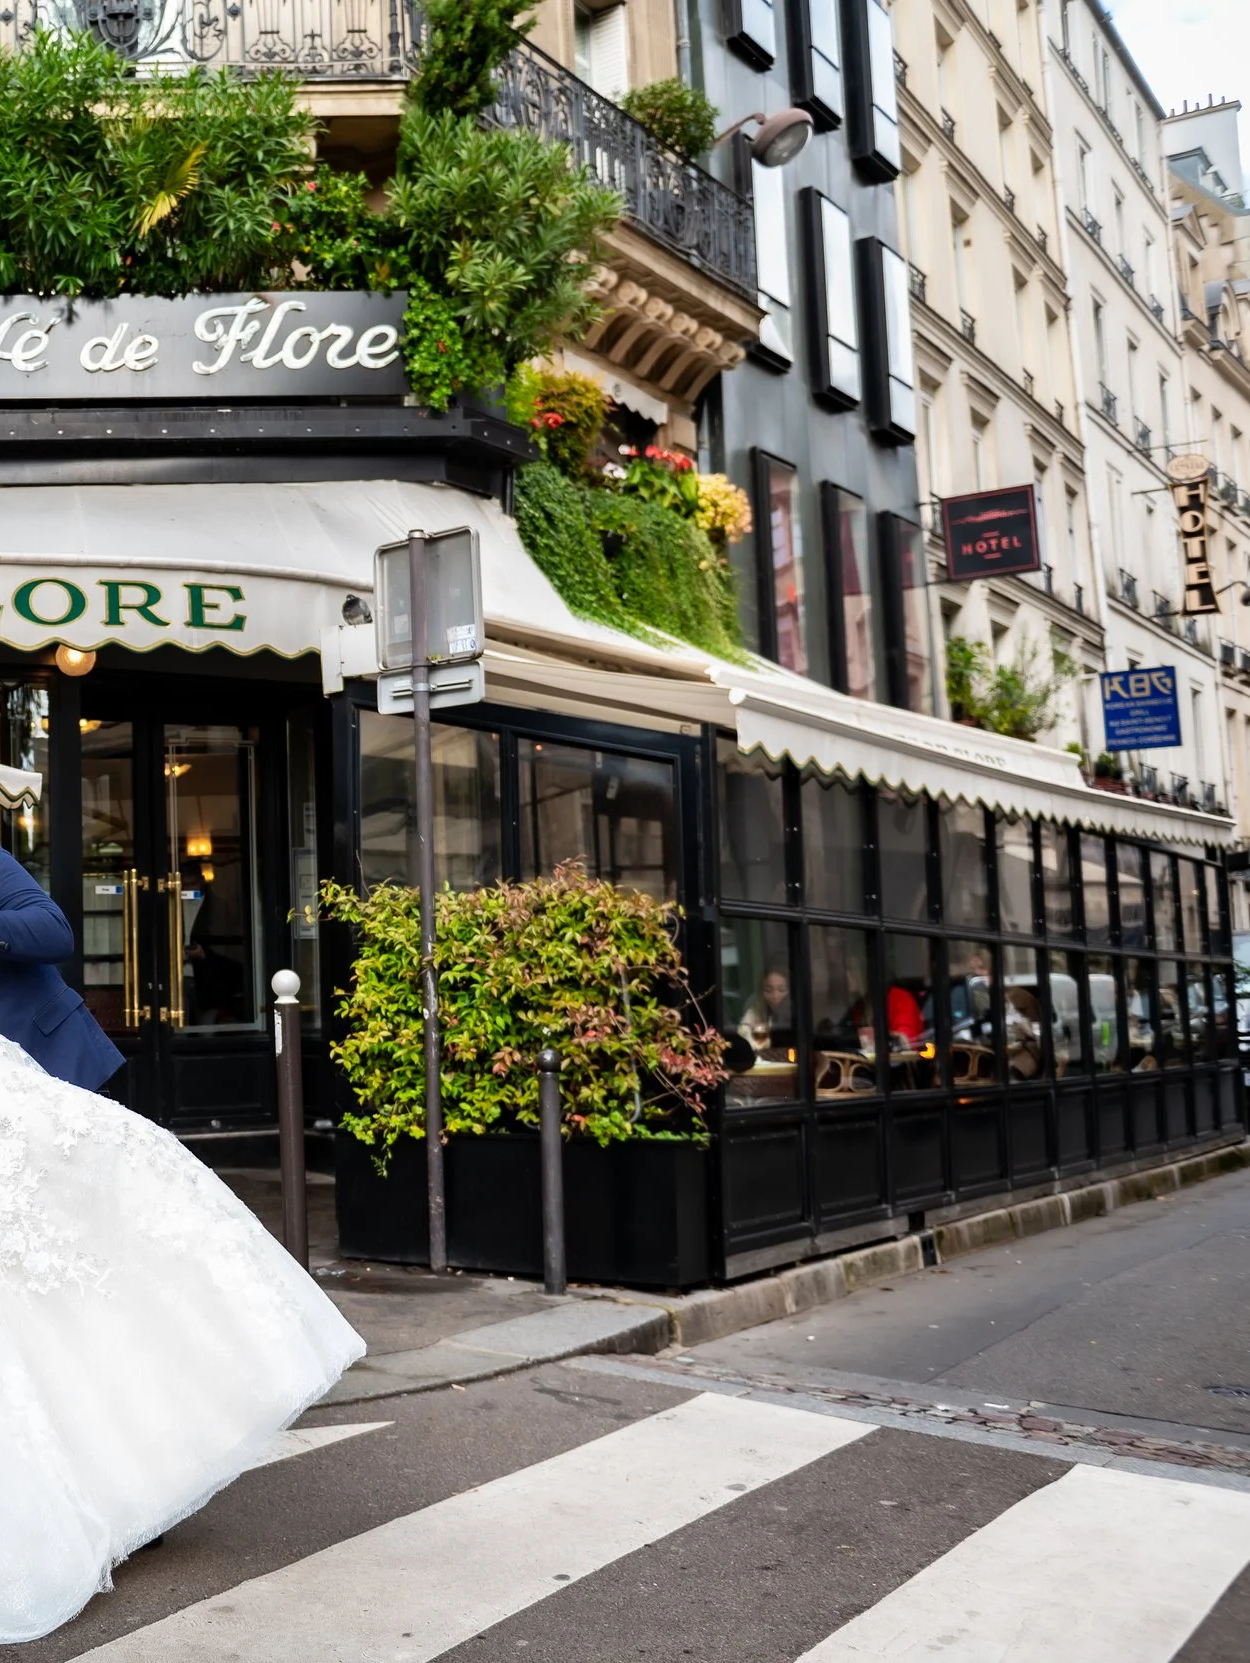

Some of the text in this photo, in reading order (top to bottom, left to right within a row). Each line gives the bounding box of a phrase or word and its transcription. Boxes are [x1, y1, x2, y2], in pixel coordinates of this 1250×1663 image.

[78, 322, 160, 373] de
[191, 297, 400, 376] Flore
[961, 535, 1022, 555] HOTEL
[1172, 482, 1217, 612] HOTEL
